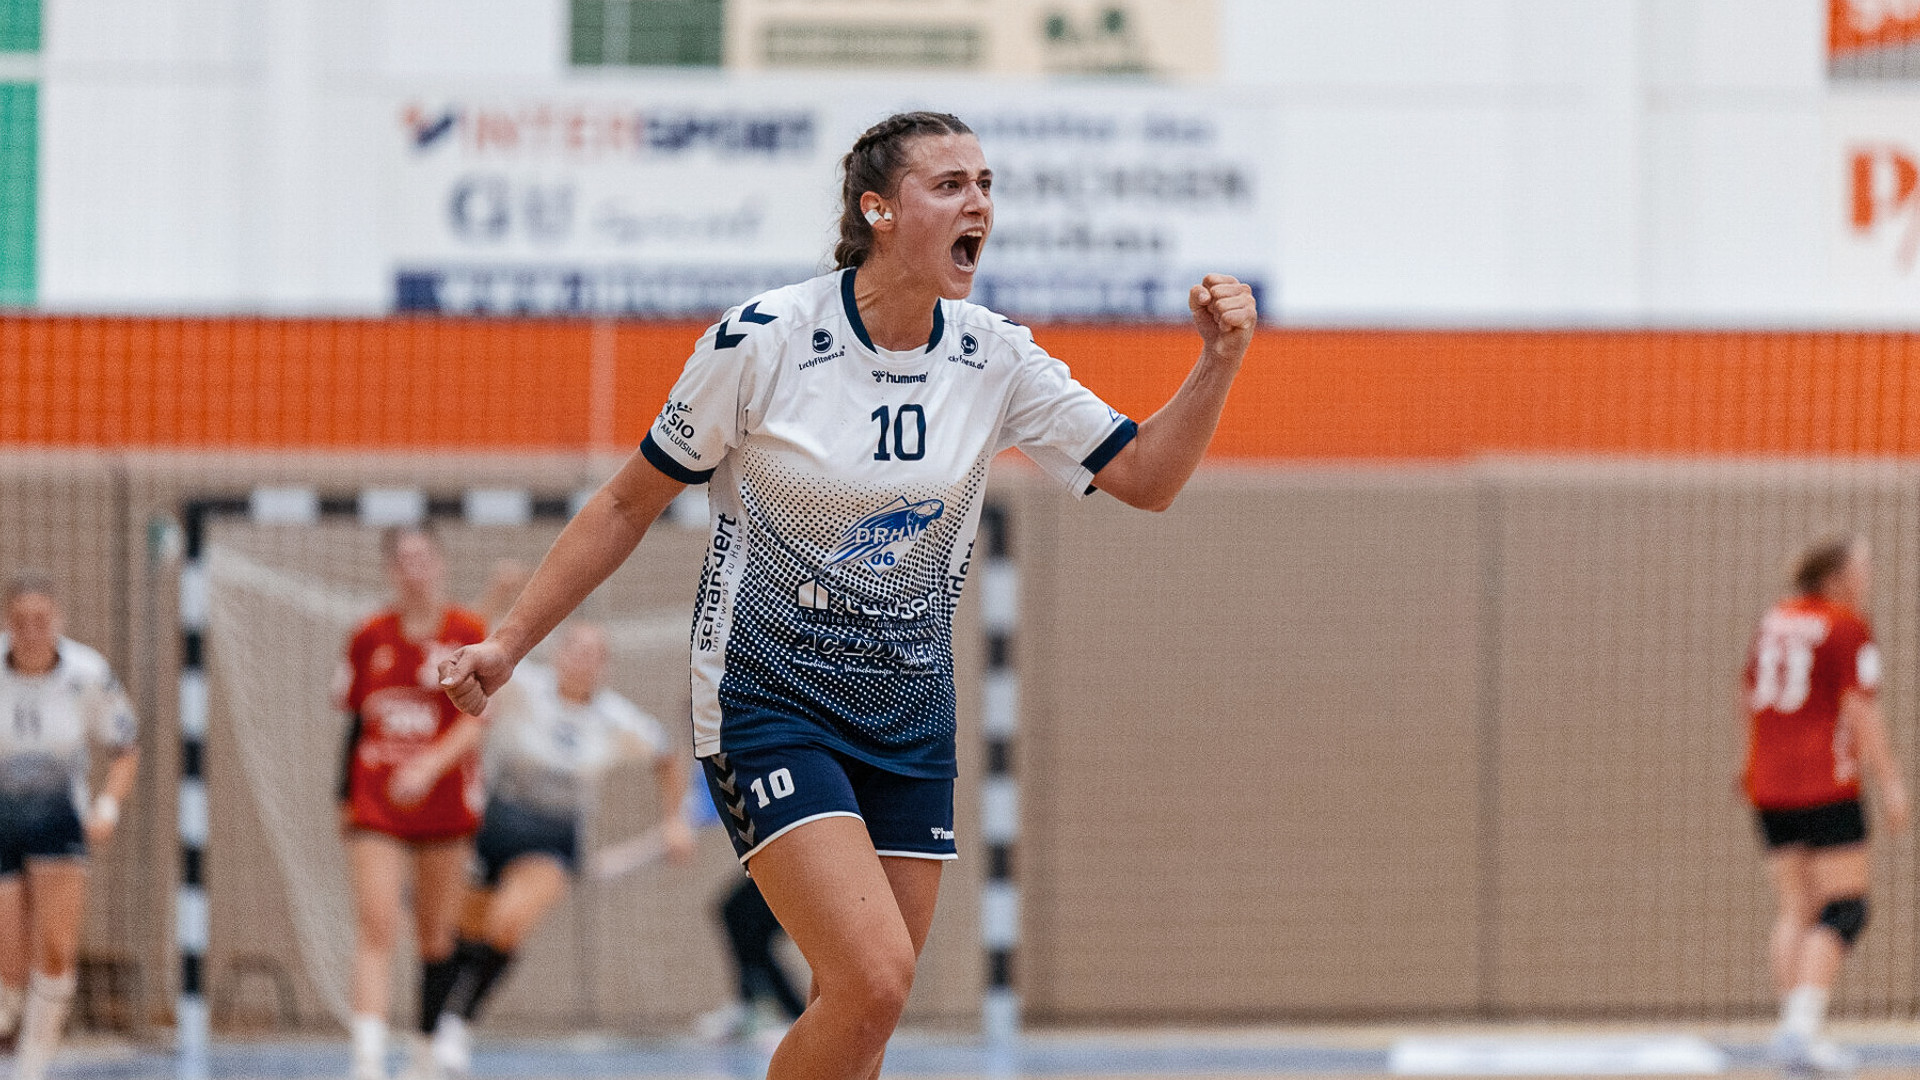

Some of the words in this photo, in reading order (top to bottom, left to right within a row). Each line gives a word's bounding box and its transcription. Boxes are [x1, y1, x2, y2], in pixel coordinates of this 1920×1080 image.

[458, 105, 815, 155] INTERSPORT
[669, 433, 702, 461] LUISIUM
[870, 404, 927, 462] 10
[855, 523, 920, 545] DRHV
[871, 551, 896, 566] 06
[796, 611, 874, 627] Architekten
[750, 767, 796, 809] 10
